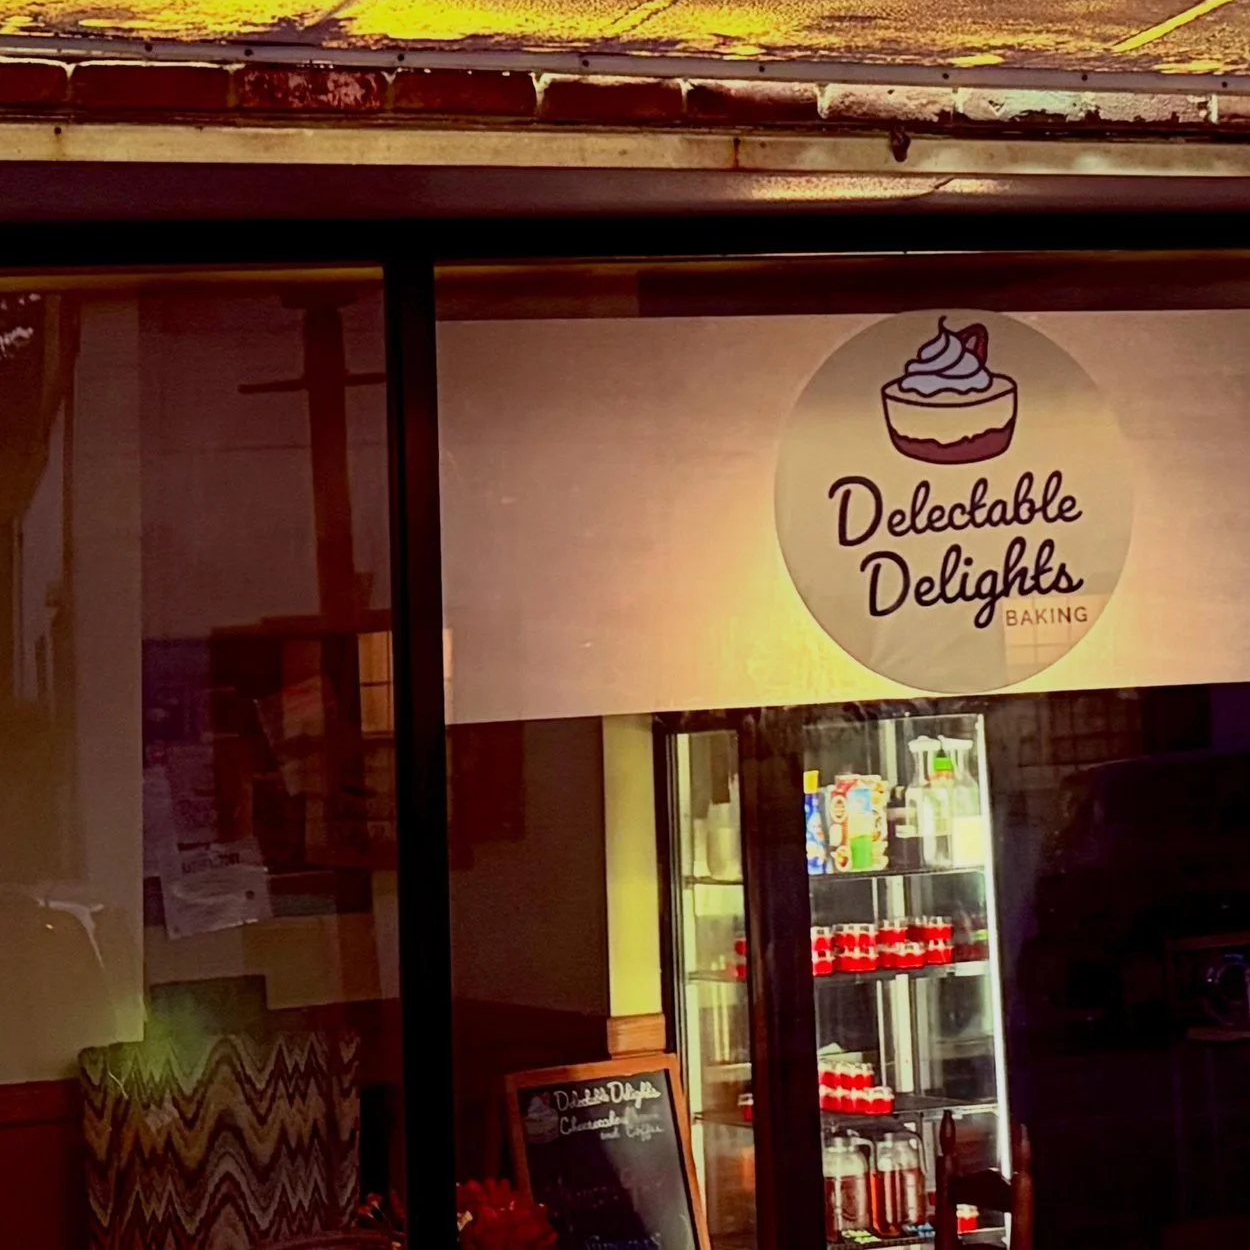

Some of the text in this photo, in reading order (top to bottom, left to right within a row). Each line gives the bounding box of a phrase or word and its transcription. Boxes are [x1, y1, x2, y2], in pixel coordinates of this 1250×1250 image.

[828, 470, 1083, 547] Delectable
[860, 536, 1084, 629] Delights
[1005, 606, 1089, 628] BAKING
